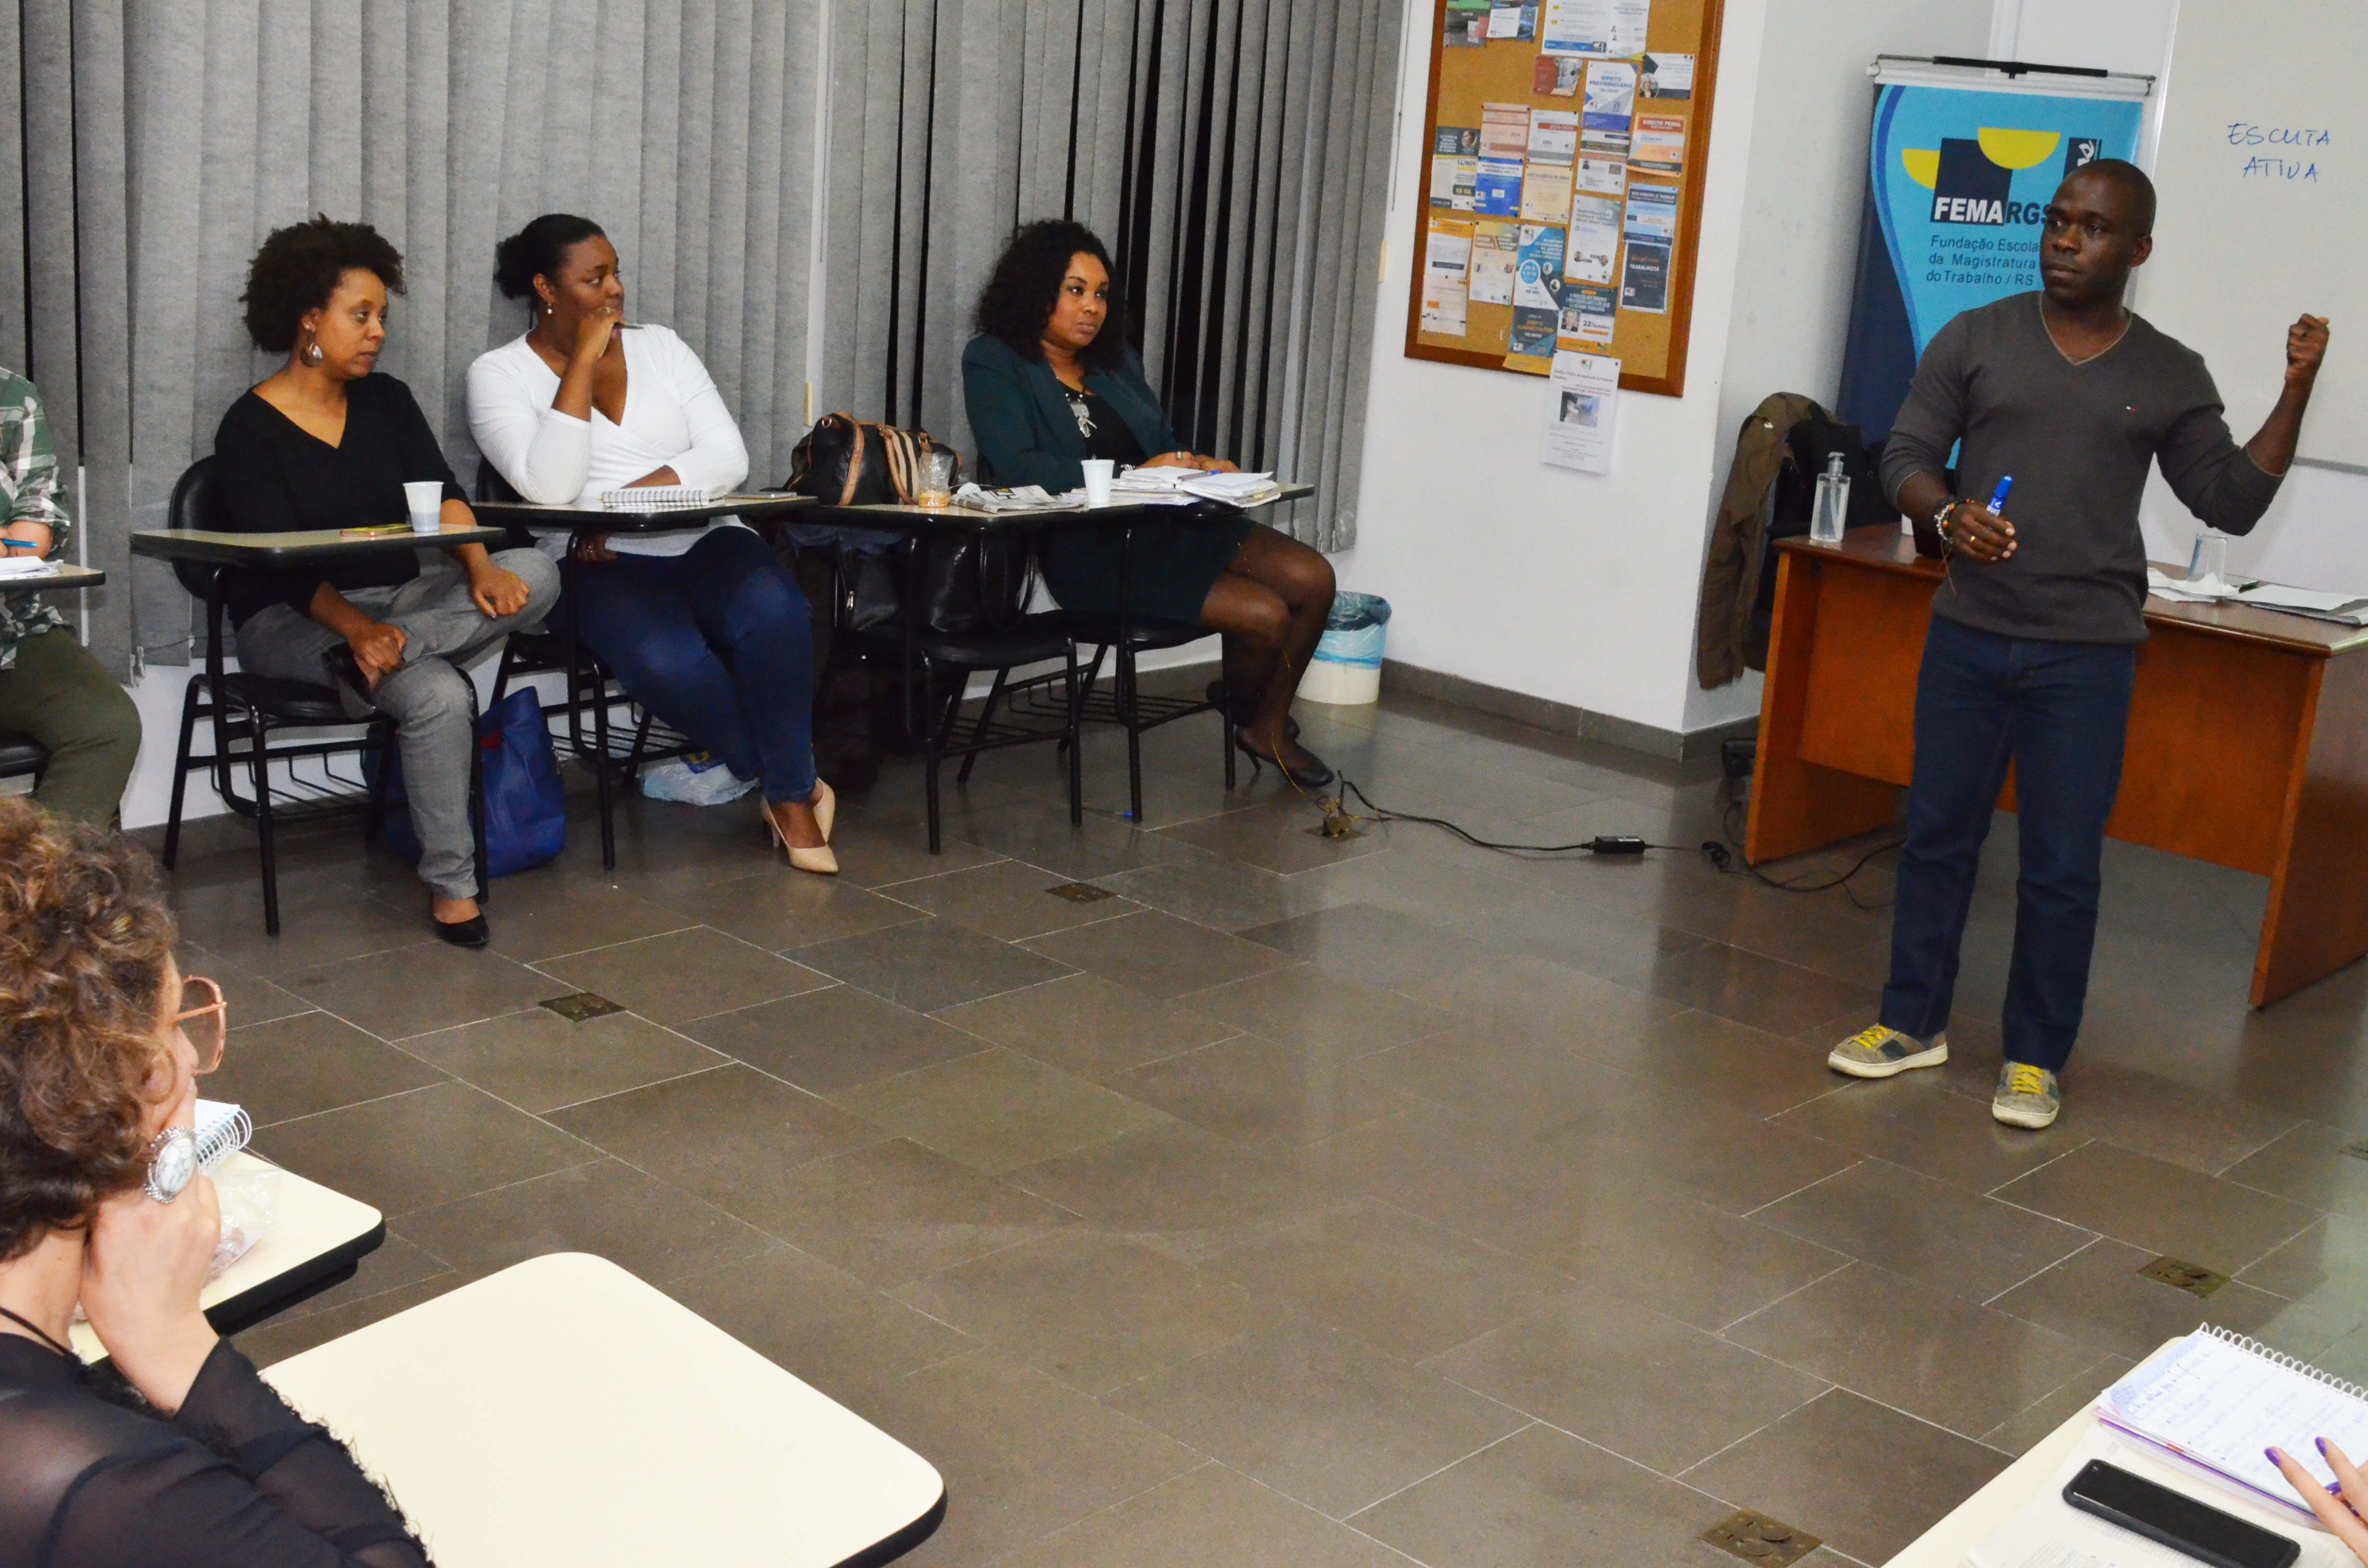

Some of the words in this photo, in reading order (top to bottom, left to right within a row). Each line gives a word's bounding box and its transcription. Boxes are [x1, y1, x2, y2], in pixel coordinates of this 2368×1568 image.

[2227, 123, 2330, 146] ESCUTA
[2243, 156, 2319, 184] ATIVA
[1931, 235, 1994, 252] Fundação
[1997, 239, 2038, 253] Escola
[1929, 253, 1943, 265] da
[1952, 254, 2036, 269] Magistratura
[1926, 270, 1941, 282] do
[1944, 270, 2002, 284] Trabalho
[2014, 274, 2034, 286] RS
